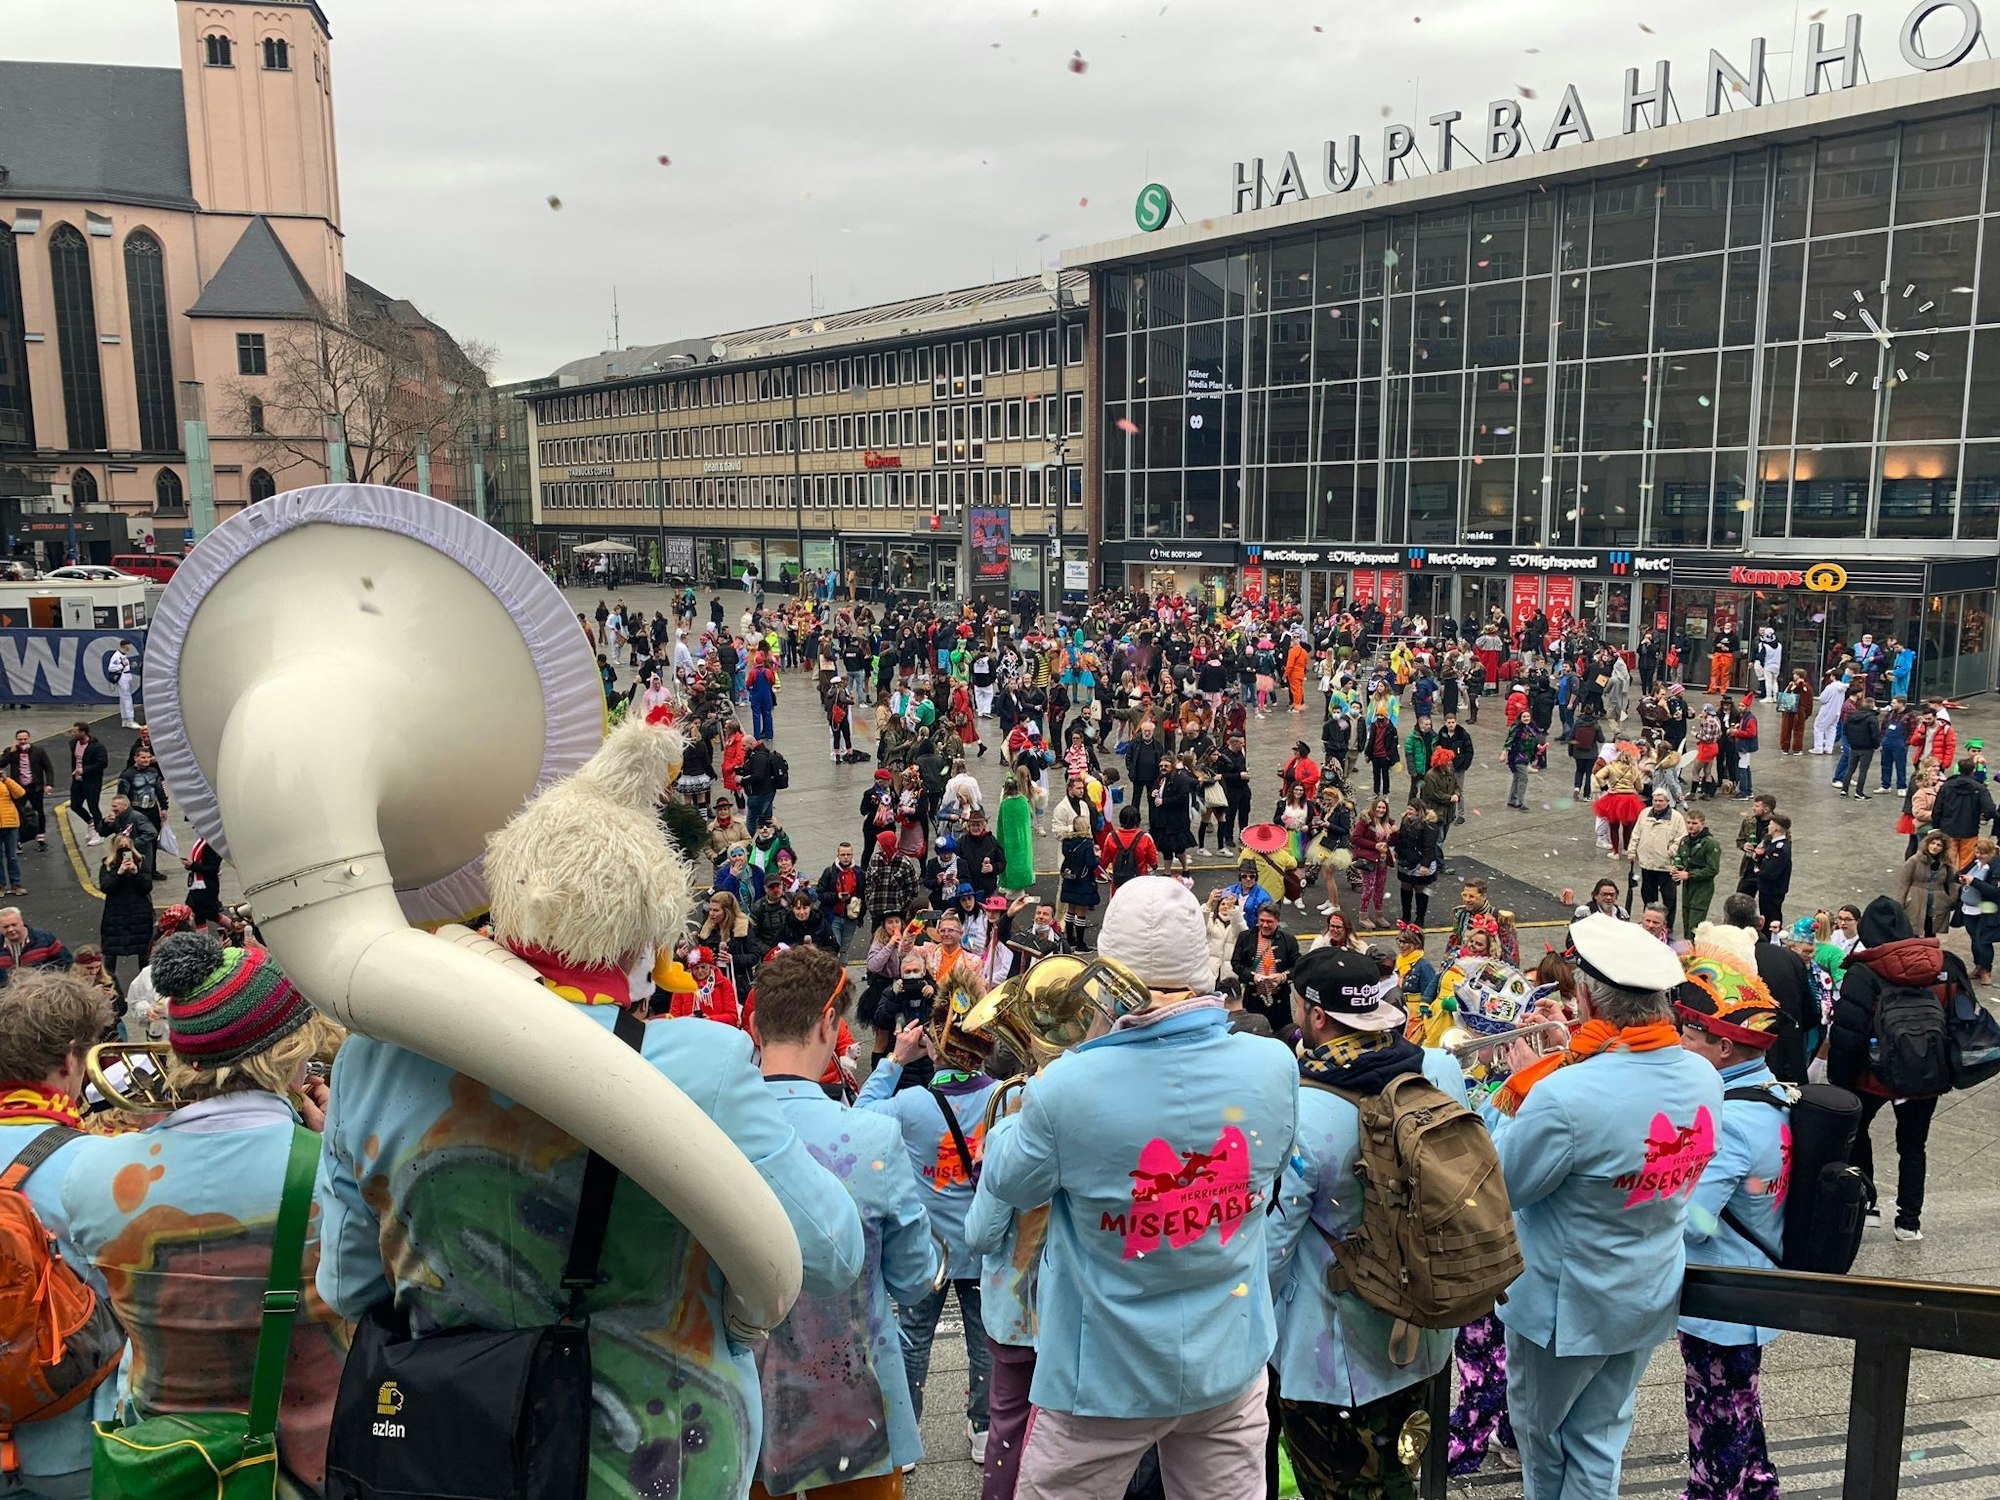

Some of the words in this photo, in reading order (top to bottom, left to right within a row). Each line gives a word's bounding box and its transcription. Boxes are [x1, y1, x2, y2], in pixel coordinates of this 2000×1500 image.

[1233, 0, 1981, 213] HAUPTBAHNHO
[1140, 189, 1162, 226] S
[1187, 369, 1209, 379] Kölner
[1187, 380, 1208, 389] Media
[594, 467, 613, 477] COFFEE
[1171, 551, 1186, 559] BODY
[1187, 551, 1203, 559] SHOP
[1263, 550, 1319, 562] NetCologne
[1344, 552, 1399, 565] Highspeed
[1427, 552, 1497, 568] NetCologne
[1529, 554, 1597, 570] Highspeed
[1635, 557, 1670, 571] NetC
[1730, 565, 1803, 588] Kamps
[0, 636, 142, 698] WC
[372, 1420, 406, 1438] azlan
